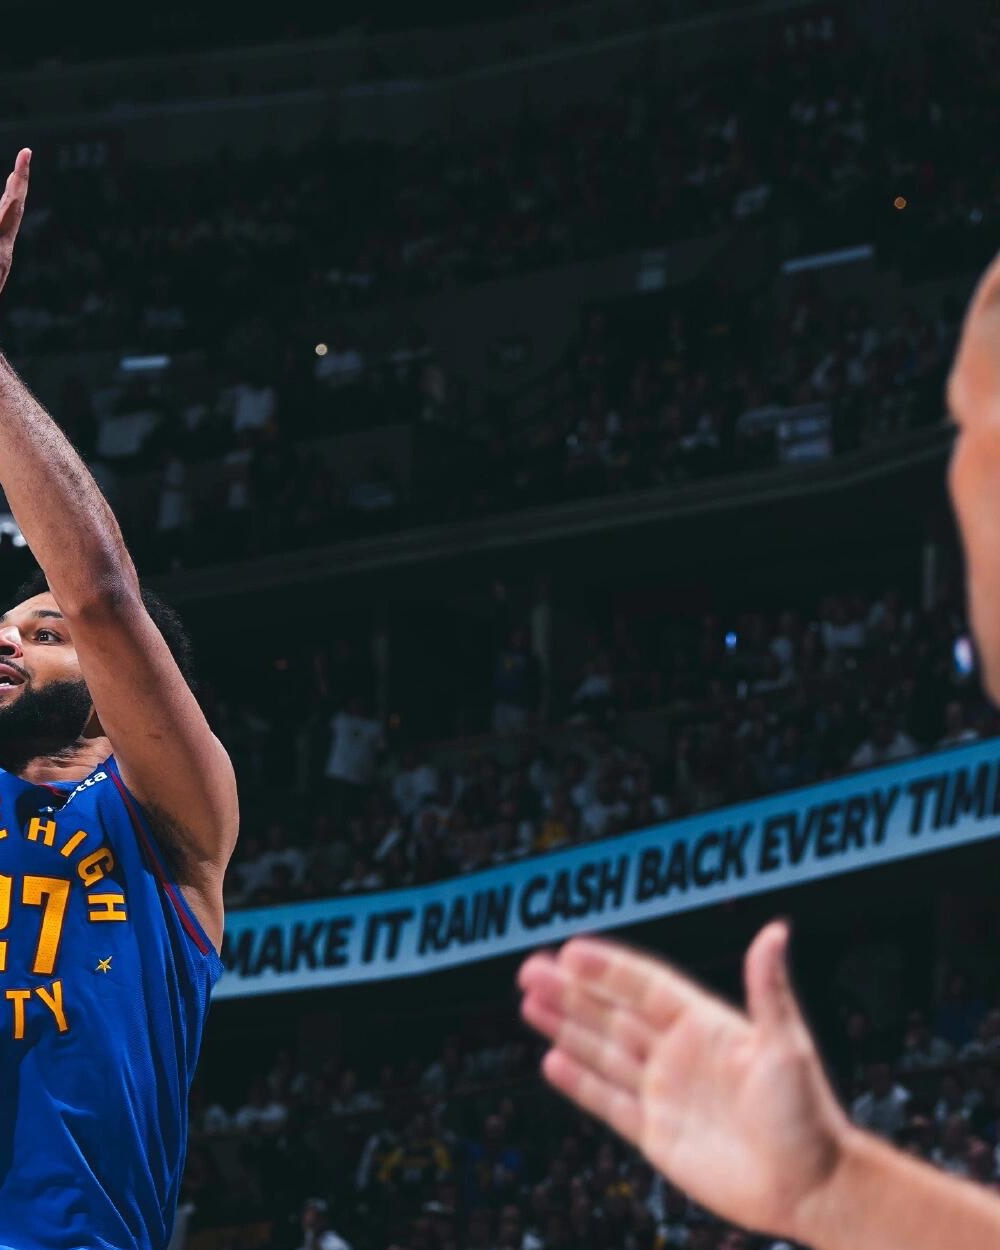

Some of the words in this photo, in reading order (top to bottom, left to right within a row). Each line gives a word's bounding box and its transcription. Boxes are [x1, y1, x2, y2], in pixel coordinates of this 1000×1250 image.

[27, 816, 128, 923] HIGH
[221, 914, 354, 980] MAKE
[360, 906, 415, 966] IT
[417, 884, 513, 957] RAIN
[518, 855, 630, 930] CASH
[634, 821, 756, 904] BACK
[757, 784, 902, 874] EVERY
[906, 756, 1000, 837] TIM
